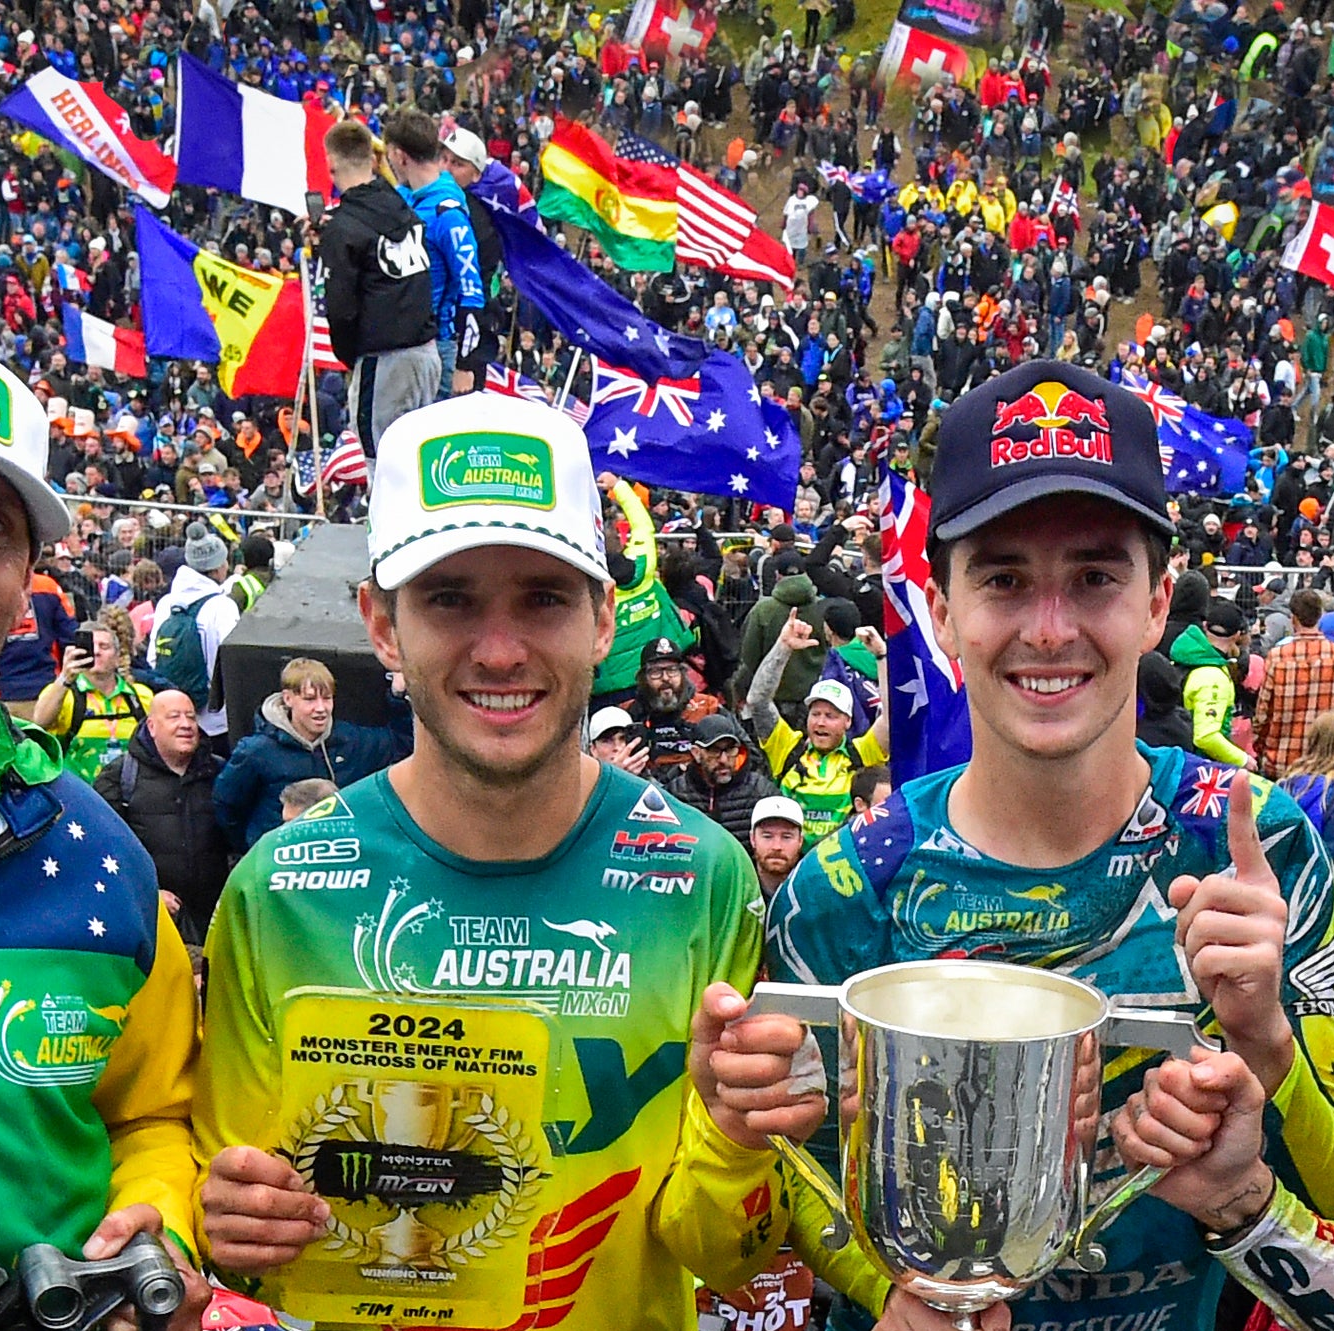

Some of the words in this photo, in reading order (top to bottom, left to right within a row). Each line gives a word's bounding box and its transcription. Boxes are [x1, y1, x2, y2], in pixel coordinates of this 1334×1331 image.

[467, 453, 502, 468] TEAM
[991, 428, 1052, 468] Red
[1053, 428, 1113, 465] Bull
[462, 469, 543, 489] AUSTRALIA
[806, 811, 832, 821] TEAM
[273, 838, 361, 865] WPS
[610, 830, 700, 856] HRC
[269, 868, 371, 891] SHOWA
[601, 867, 696, 895] MXON
[448, 916, 530, 946] TEAM
[944, 910, 1070, 934] AUSTRALIA
[432, 949, 631, 988] AUSTRALIA
[561, 990, 631, 1017] MXoN
[41, 1010, 87, 1034] TEAM
[368, 1013, 466, 1041] 2024
[300, 1036, 398, 1055] MONSTER
[403, 1042, 483, 1060] ENERGY
[489, 1048, 523, 1062] FIM
[290, 1049, 416, 1070] MOTOCROSS
[422, 1057, 449, 1072] OF
[454, 1060, 538, 1077] NATIONS
[381, 1153, 453, 1167] MONSTER
[376, 1174, 456, 1194] MXON
[361, 1267, 418, 1280] WINNING
[419, 1268, 457, 1282] TEAM
[1012, 1260, 1195, 1302] NDA
[351, 1302, 394, 1317] FIM
